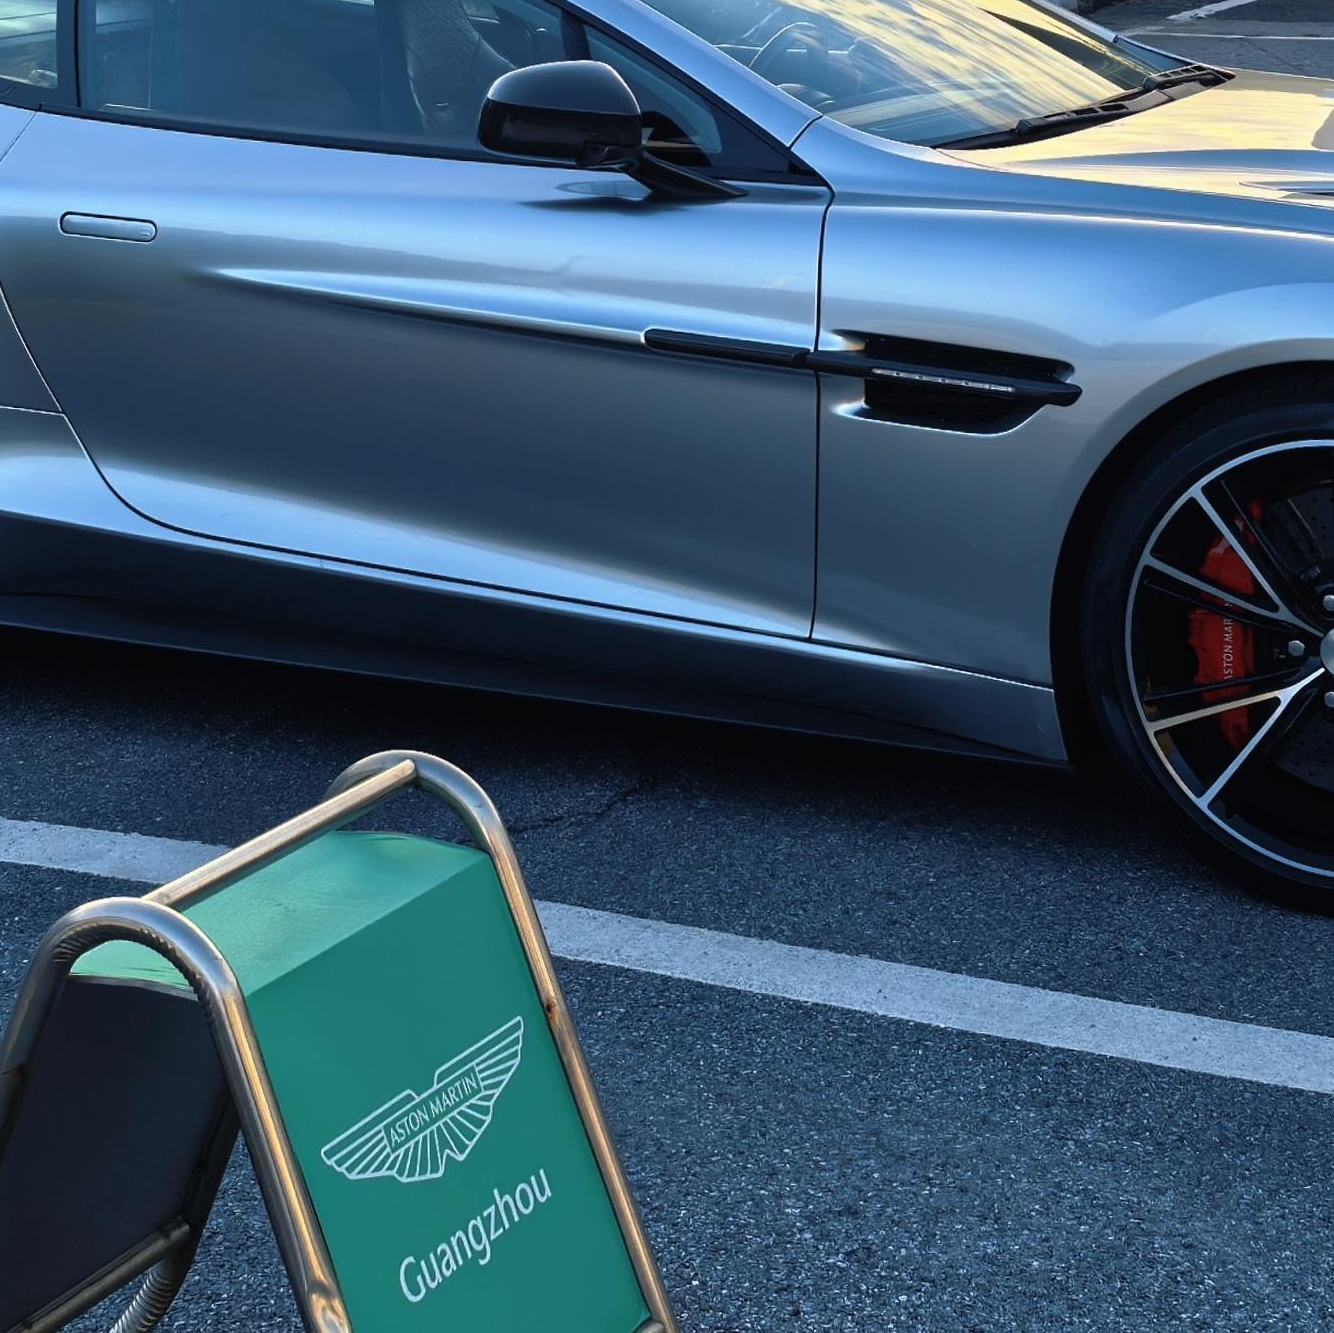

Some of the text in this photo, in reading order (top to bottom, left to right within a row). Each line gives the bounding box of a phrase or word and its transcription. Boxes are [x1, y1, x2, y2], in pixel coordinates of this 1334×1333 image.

[388, 1072, 478, 1148] ASTON MARTIN
[399, 1168, 553, 1303] Guangzhou
